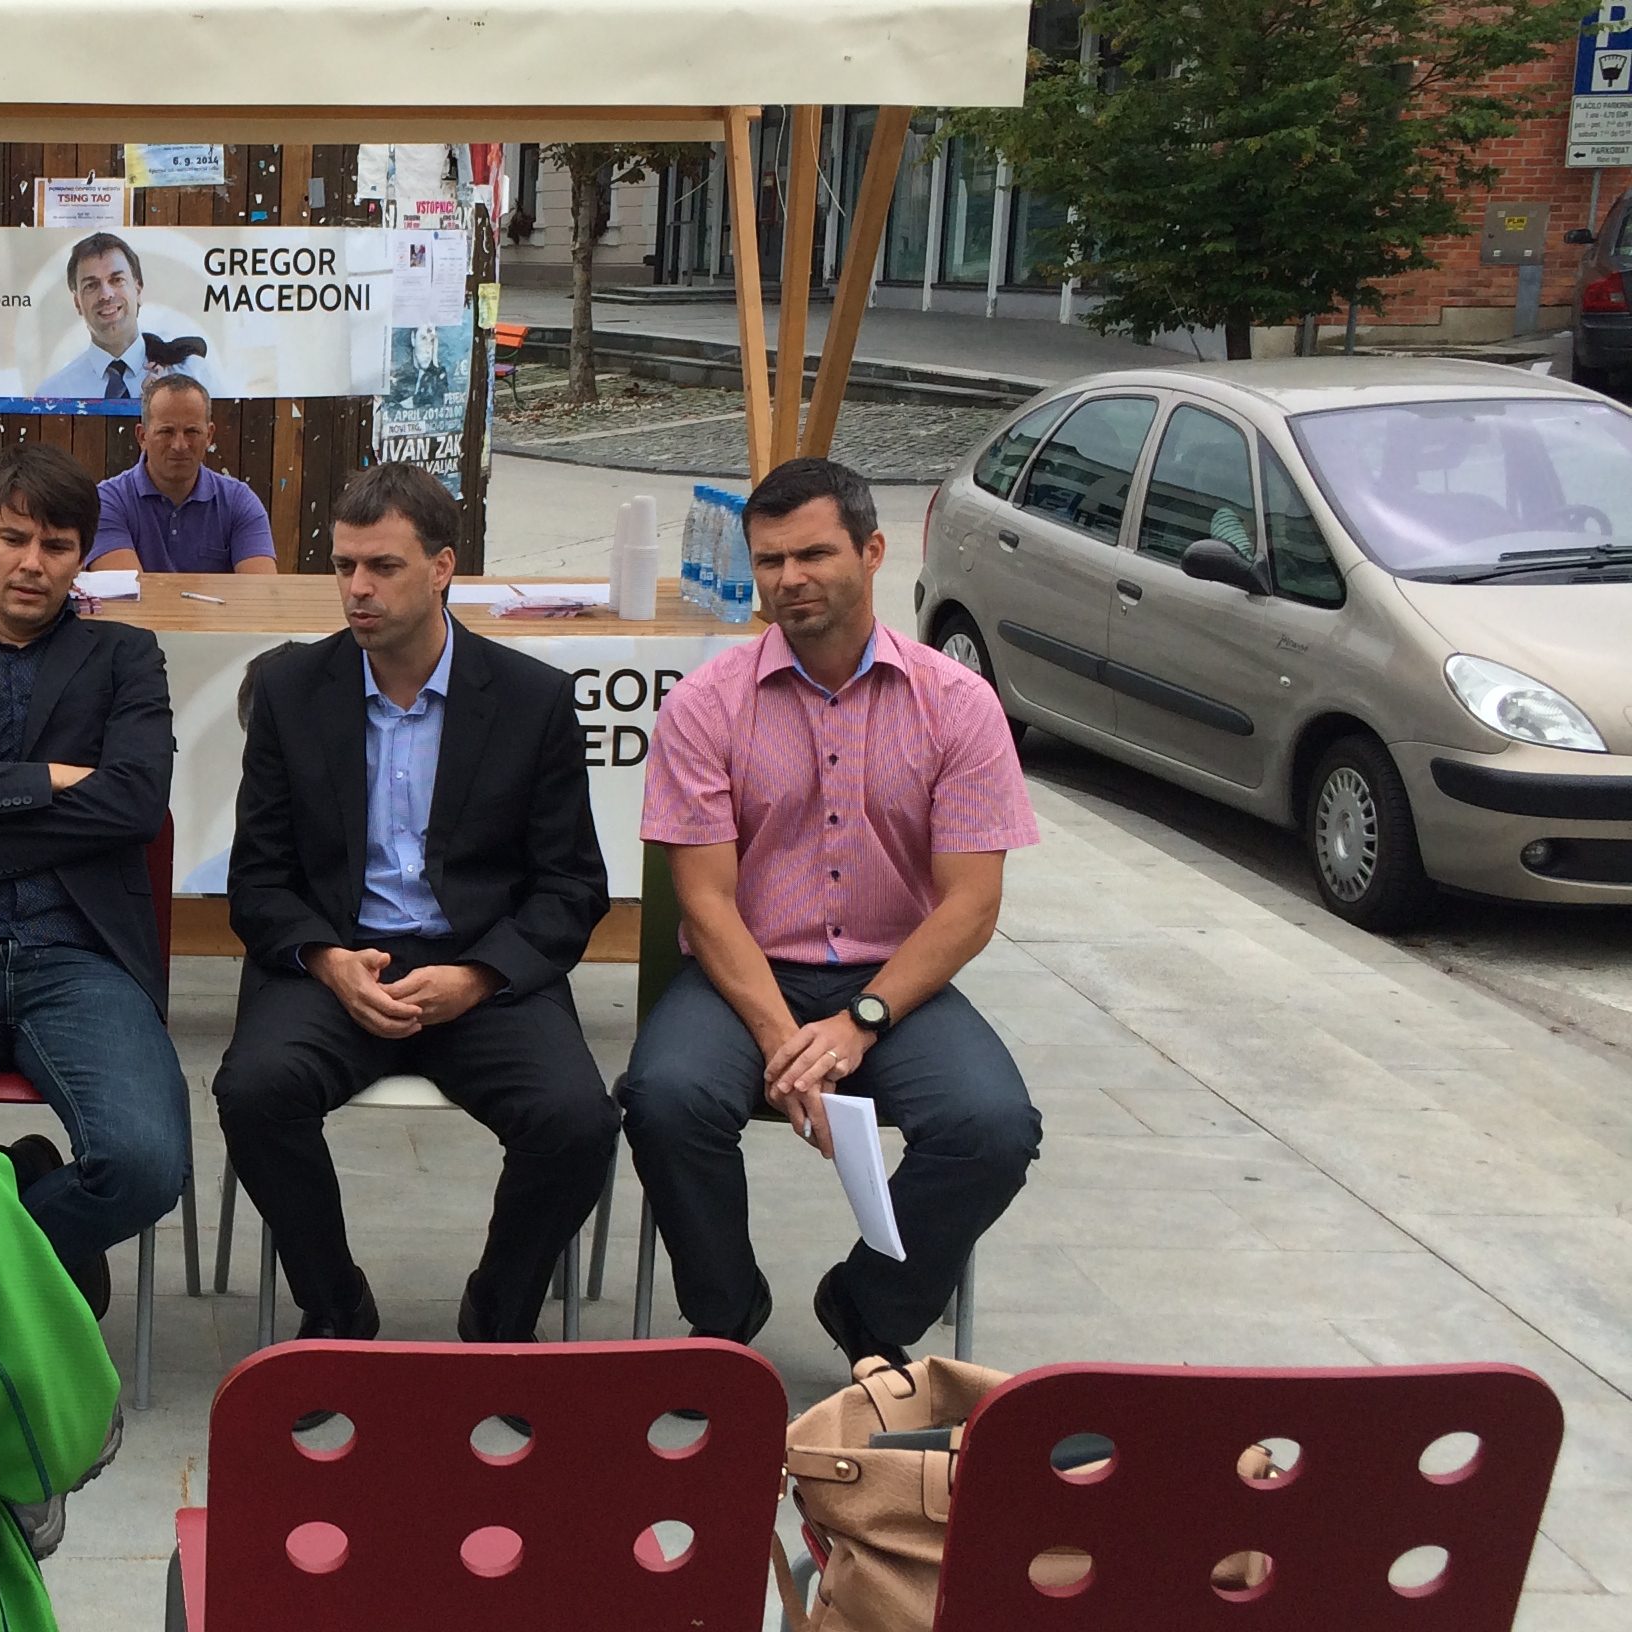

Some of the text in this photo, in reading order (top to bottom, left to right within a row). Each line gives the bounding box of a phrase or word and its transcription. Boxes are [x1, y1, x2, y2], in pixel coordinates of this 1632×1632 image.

[196, 156, 219, 166] 2014
[58, 193, 112, 203] TSING TAO
[204, 248, 336, 276] GREGOR
[203, 284, 370, 312] MACEDONI
[394, 409, 421, 422] APRIL
[422, 407, 445, 421] 2014
[382, 437, 431, 463] IVAN
